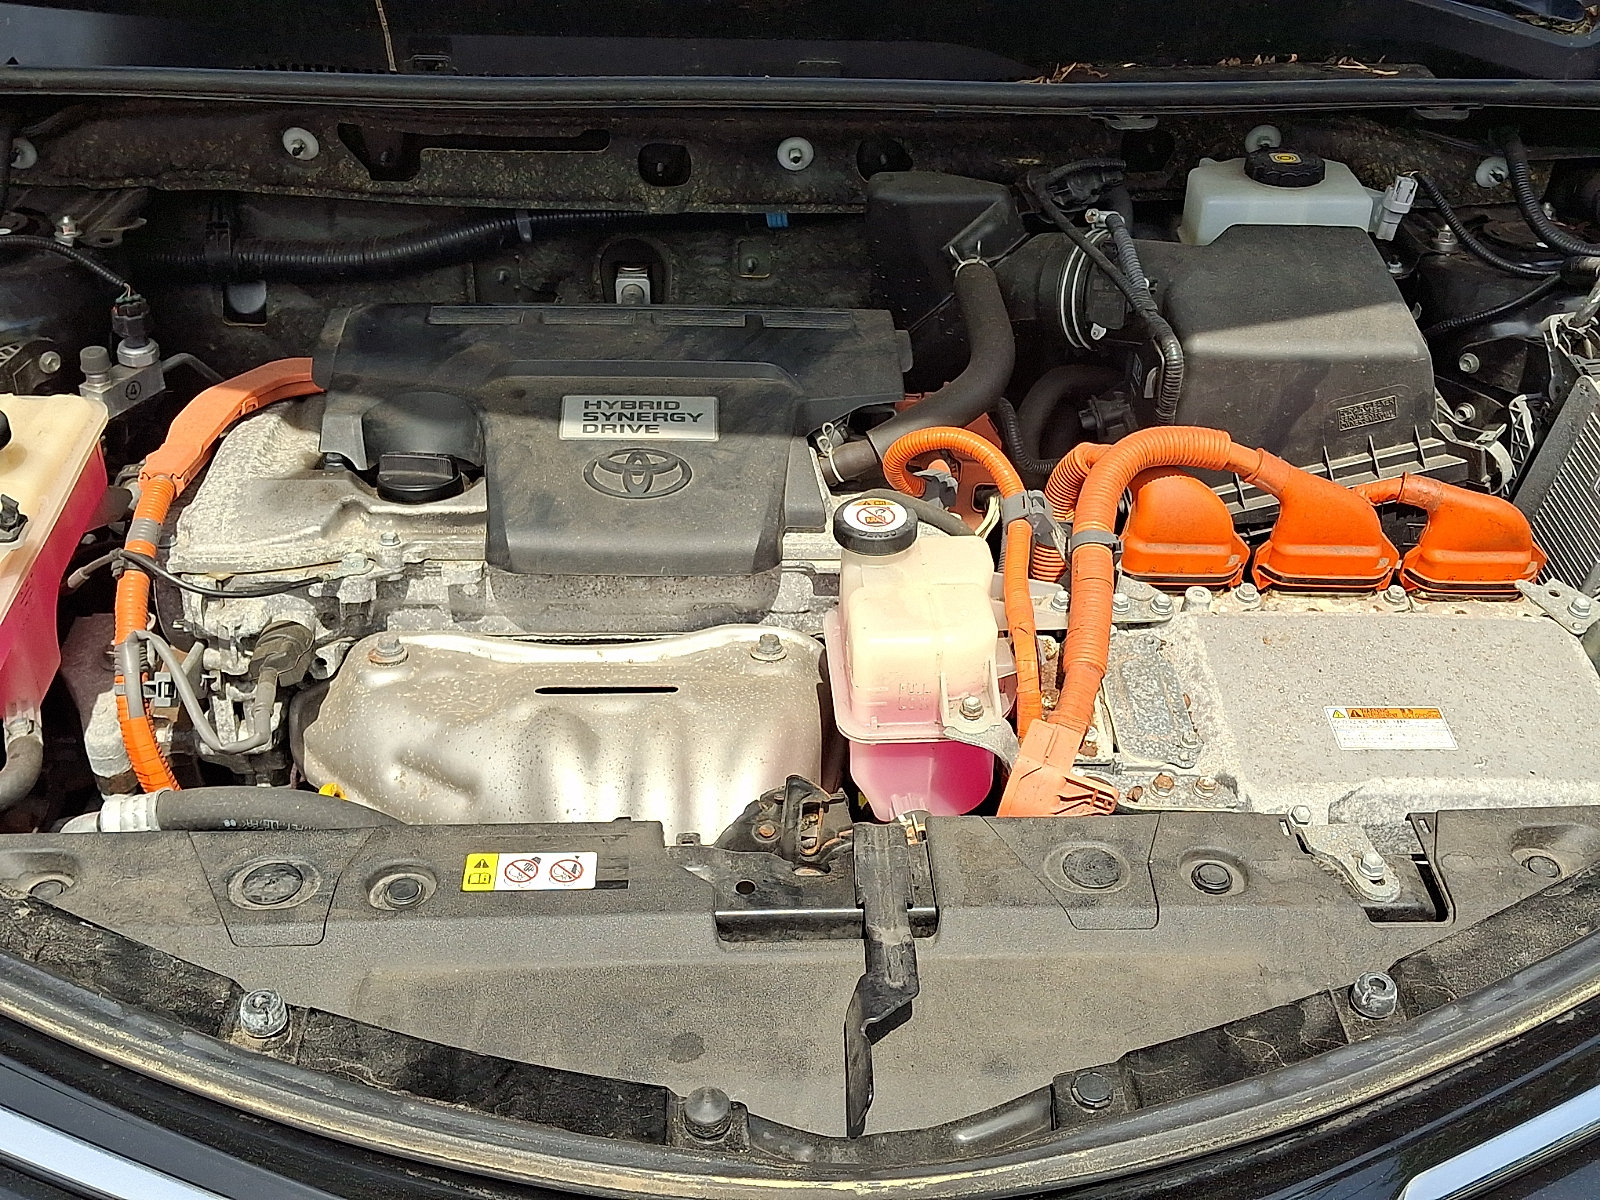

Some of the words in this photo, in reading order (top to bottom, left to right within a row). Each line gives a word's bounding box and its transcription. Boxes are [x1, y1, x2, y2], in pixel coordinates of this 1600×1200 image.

[584, 400, 680, 410] HYBRID
[583, 412, 703, 422] SYNERGY
[582, 424, 660, 434] DRIVE
